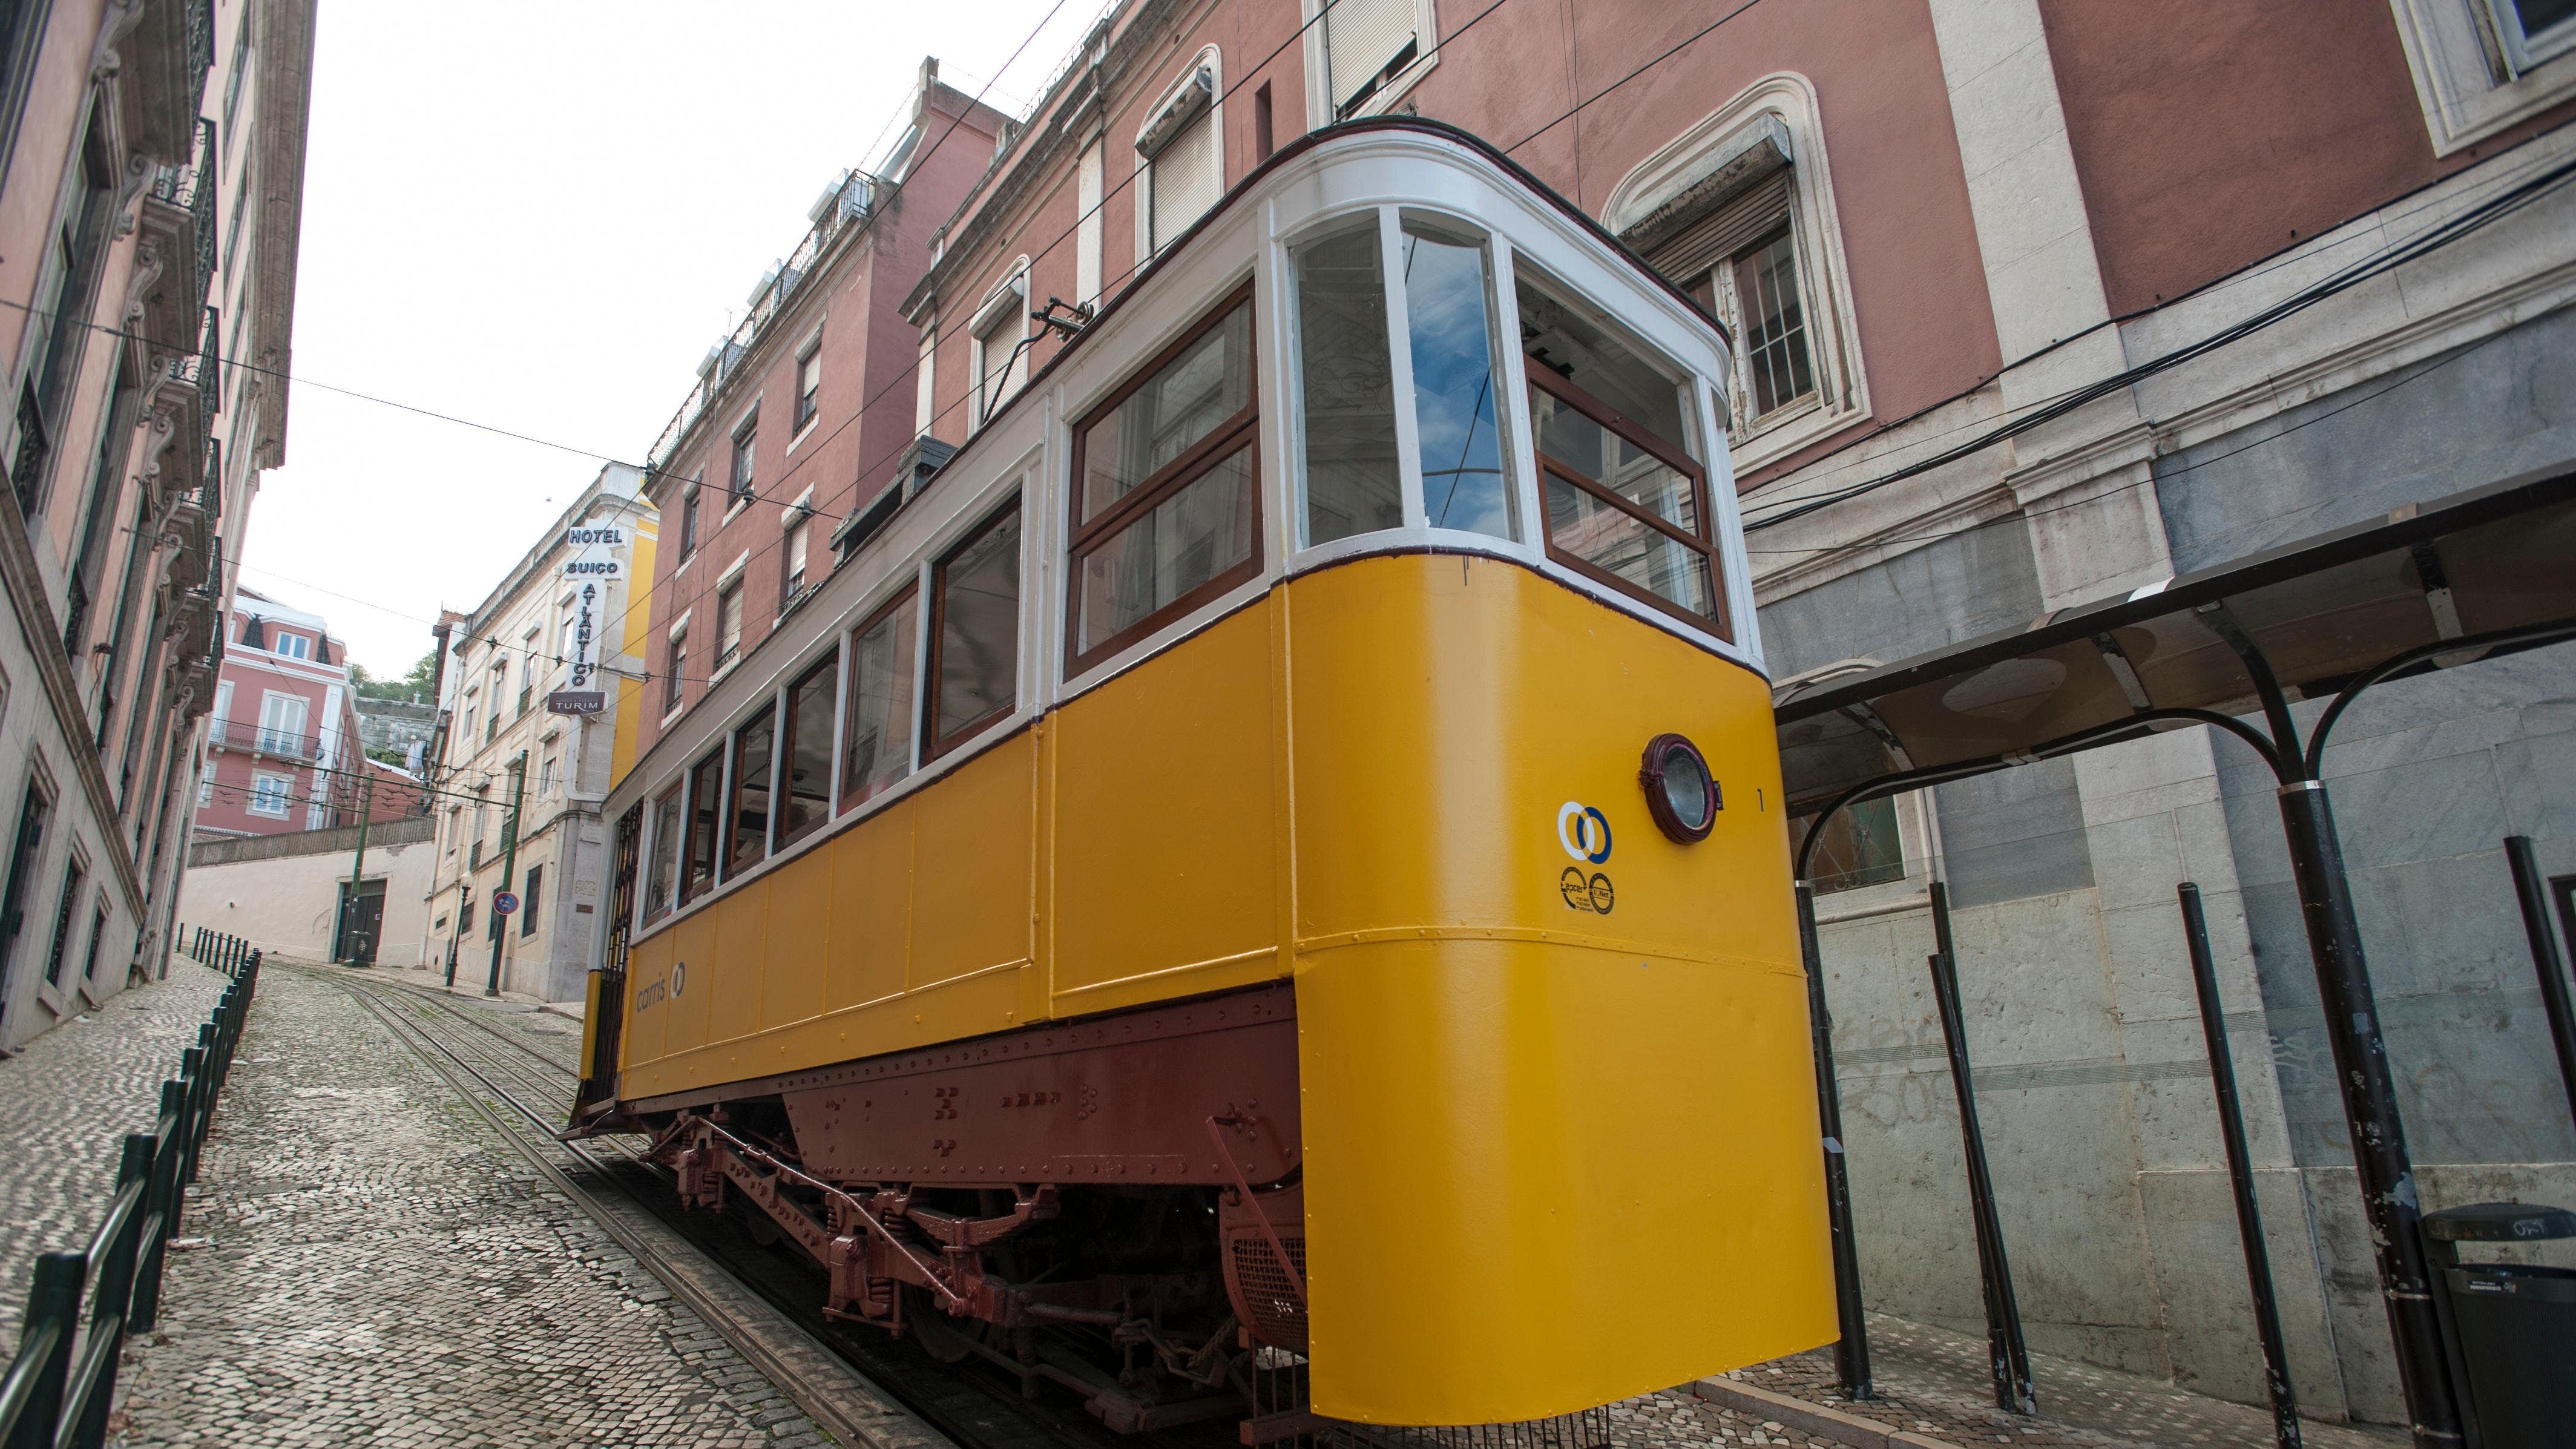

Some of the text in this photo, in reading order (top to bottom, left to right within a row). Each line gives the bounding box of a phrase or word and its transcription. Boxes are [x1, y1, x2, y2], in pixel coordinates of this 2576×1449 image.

[570, 530, 622, 543] HOTEL
[556, 703, 598, 712] TURIM
[1757, 789, 1764, 812] 1
[637, 972, 665, 1013] carris
